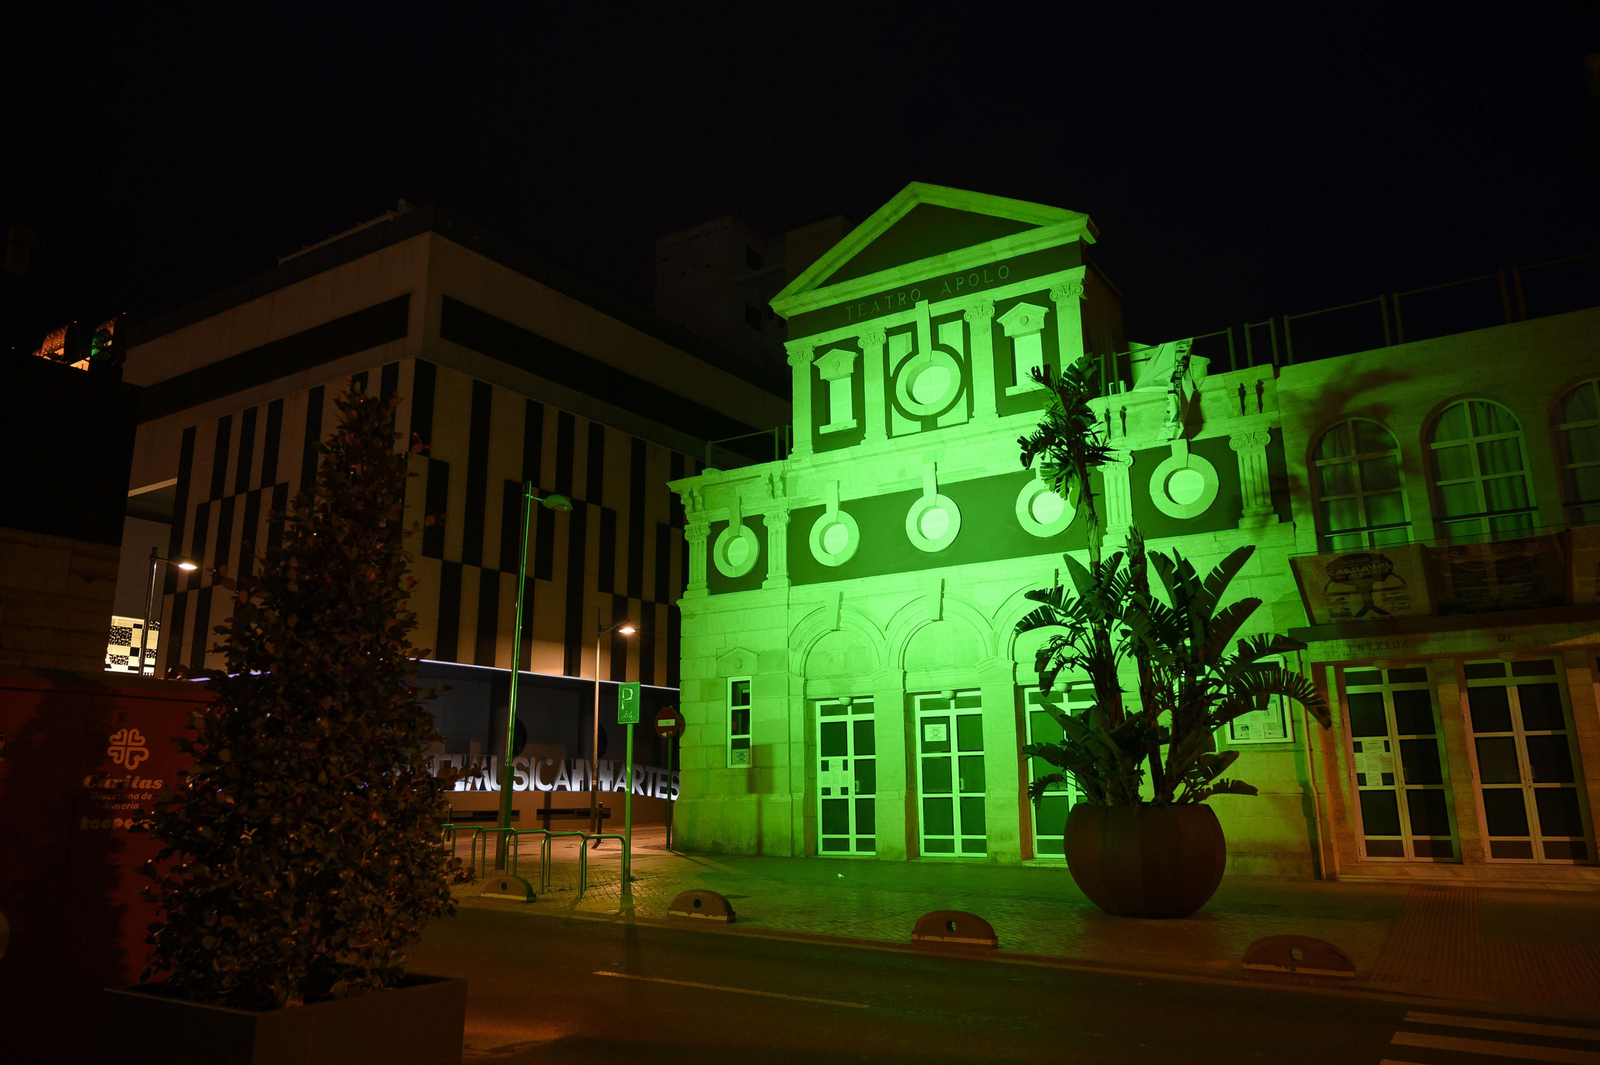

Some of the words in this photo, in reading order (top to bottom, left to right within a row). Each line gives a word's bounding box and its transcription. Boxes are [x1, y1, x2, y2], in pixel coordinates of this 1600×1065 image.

[845, 288, 921, 320] TEATRO
[940, 265, 1010, 295] APOLO
[1348, 641, 1410, 653] ENTRADA
[1497, 634, 1515, 643] DE
[621, 687, 634, 710] P
[83, 774, 164, 789] Cáritas
[613, 760, 681, 802] ARTES
[90, 791, 140, 801] Diocesana
[141, 792, 153, 801] de
[102, 801, 140, 810] Almería
